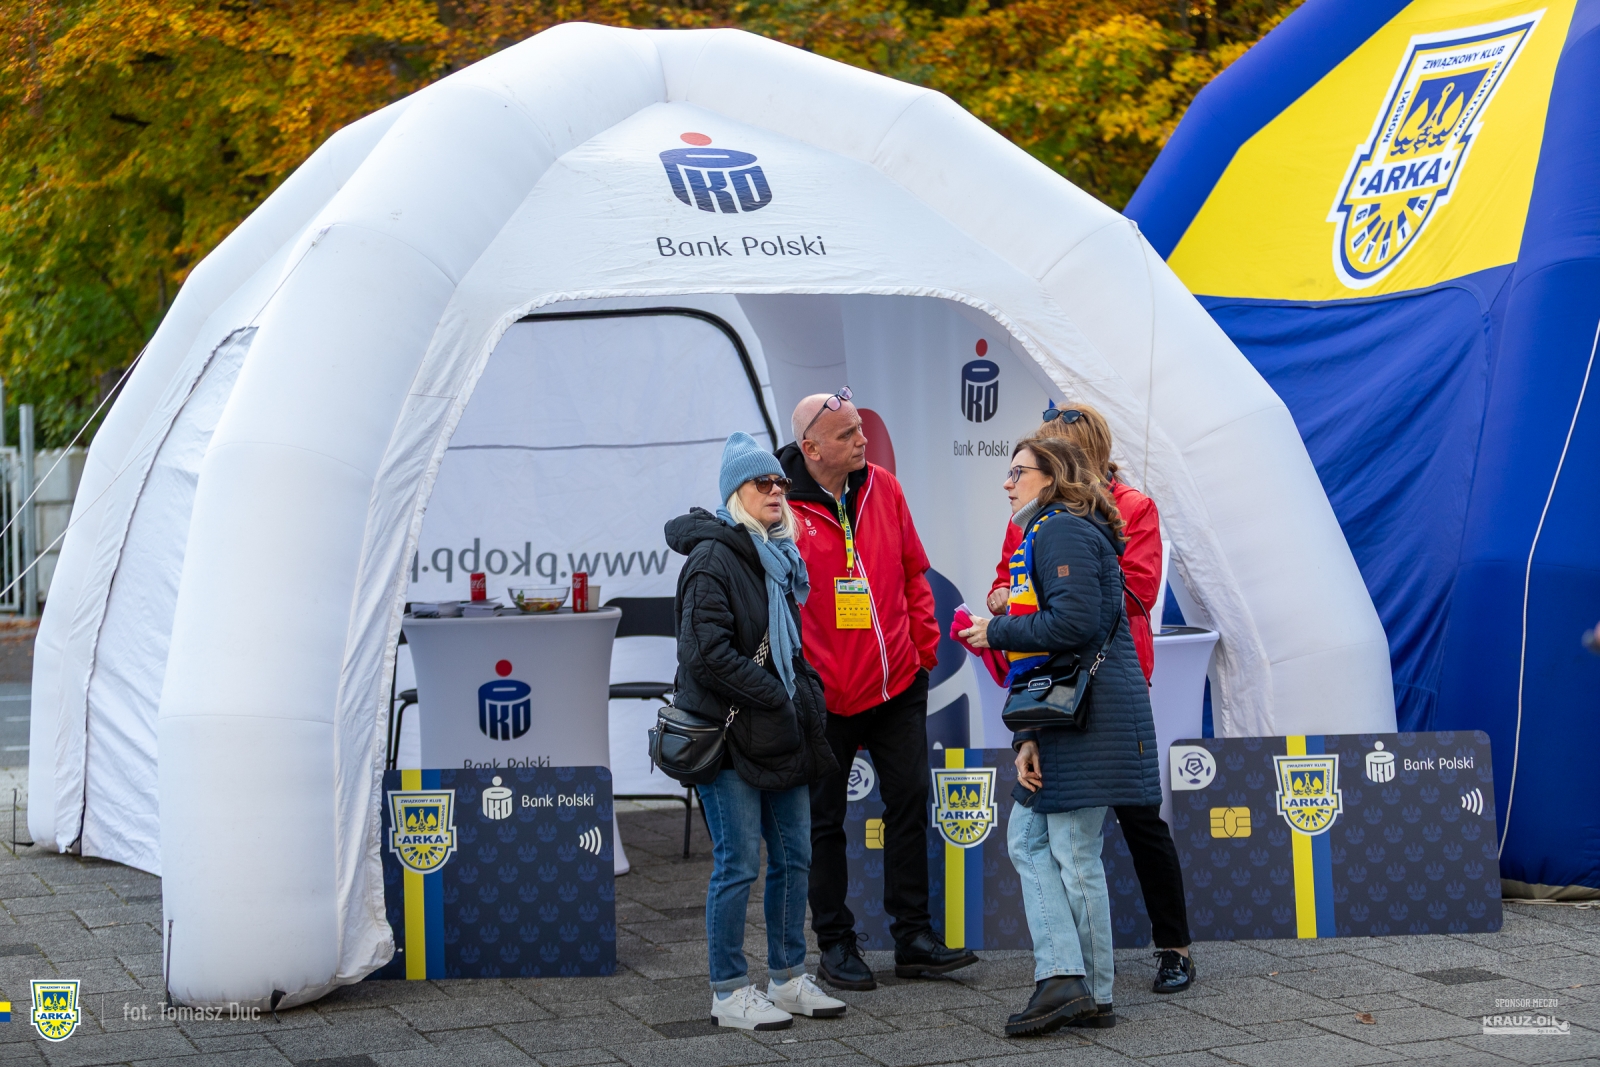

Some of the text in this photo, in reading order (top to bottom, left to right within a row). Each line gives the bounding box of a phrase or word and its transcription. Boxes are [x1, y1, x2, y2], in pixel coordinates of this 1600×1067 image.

[1423, 45, 1505, 70] ZWIĄZKOWY KLUB
[1383, 90, 1410, 143] MORSKI
[1453, 61, 1502, 138] SPORTOWY
[659, 147, 773, 214] PKO
[1362, 158, 1442, 196] ARKA
[656, 235, 827, 257] Bank Polski
[1353, 199, 1428, 262] GDYNIA
[961, 359, 1000, 423] PKO
[953, 440, 1010, 457] Bank Polski
[478, 679, 531, 742] PKO
[463, 755, 550, 770] Bank Polski
[1365, 750, 1474, 783] PKO Bank Polski
[482, 785, 594, 820] PKO Bank Polski
[944, 810, 986, 820] ARKA
[1289, 797, 1331, 807] ARKA
[402, 834, 445, 845] ARKA
